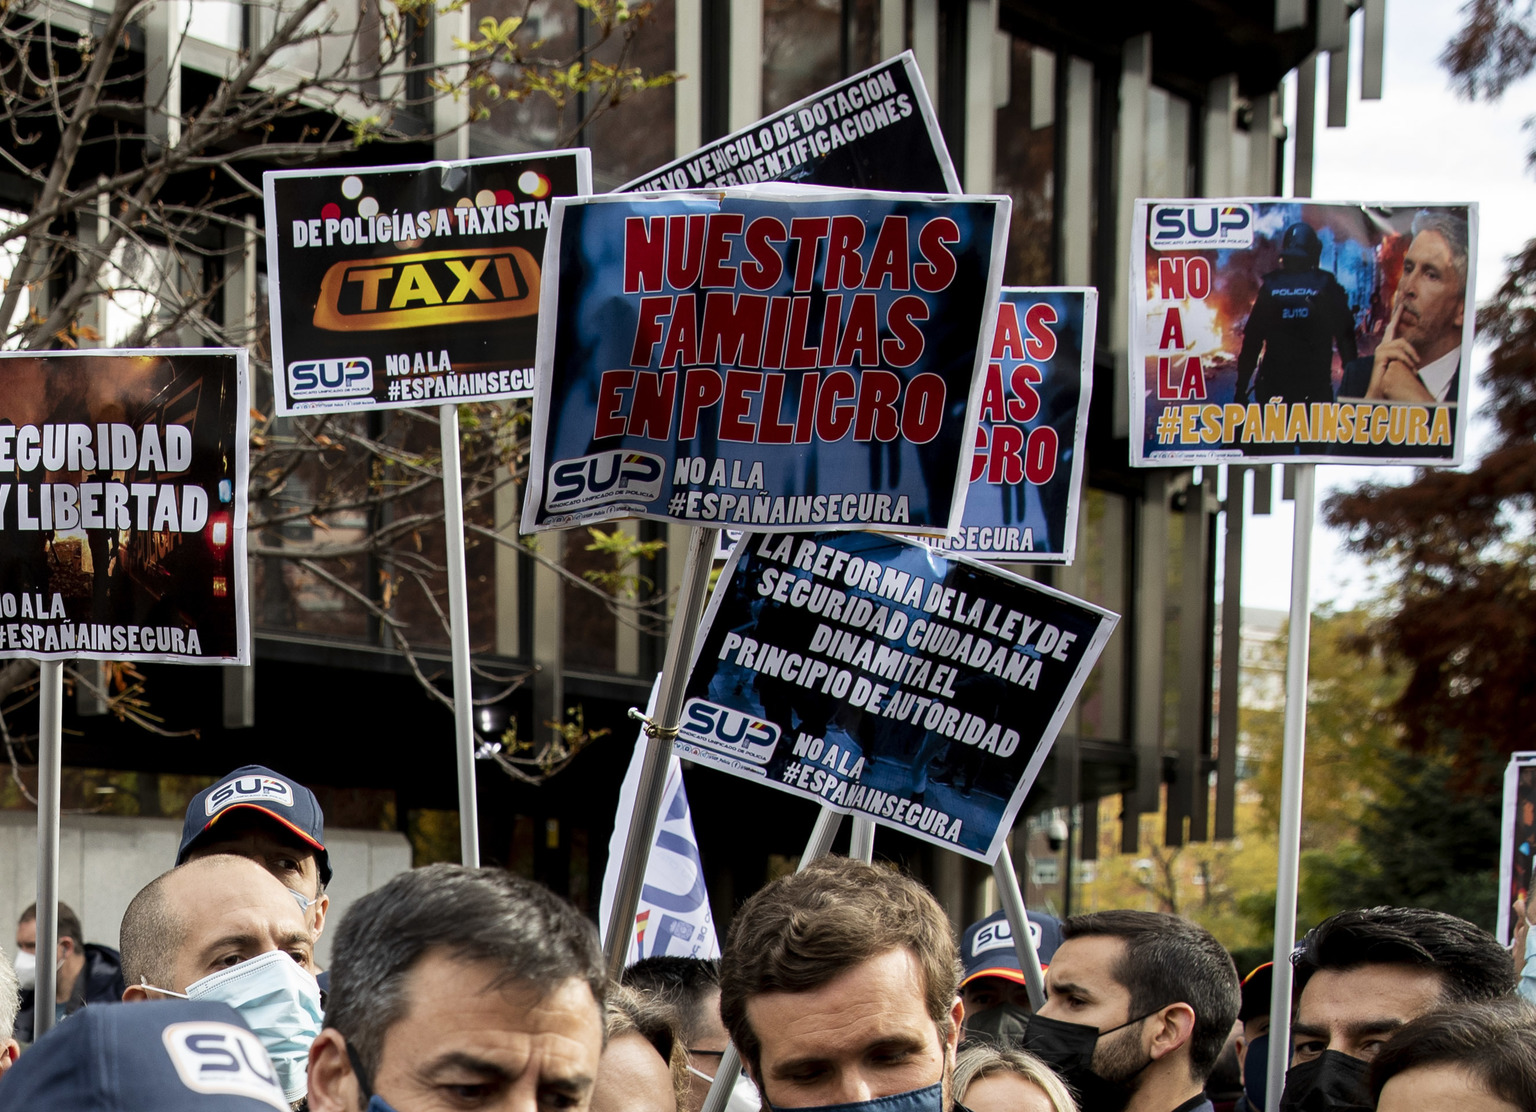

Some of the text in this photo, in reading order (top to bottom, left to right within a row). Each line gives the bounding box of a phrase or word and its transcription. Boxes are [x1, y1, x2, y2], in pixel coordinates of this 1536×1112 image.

[773, 117, 800, 147] DE
[798, 70, 897, 131] DOTACIÓN
[737, 93, 913, 186] IDENTIFICACIONES
[293, 219, 322, 248] DE
[325, 209, 431, 246] POLICÍAS
[435, 209, 451, 236] A
[1156, 207, 1249, 239] SUP
[624, 213, 959, 294] NUESTRAS
[347, 258, 519, 311] TAXI
[1158, 257, 1211, 300] NO
[630, 294, 930, 369] FAMILIAS
[1159, 307, 1185, 350] A
[293, 361, 369, 390] SUP
[386, 350, 451, 376] NO A LA
[1158, 356, 1207, 400] LA
[594, 369, 946, 445] EN PELIGRO
[1157, 396, 1452, 445] #ESPAÑAINSEGURA
[552, 454, 661, 502] SUP
[673, 457, 763, 490] NO A LA
[18, 484, 208, 532] LIBERTAD
[549, 499, 580, 509] SINDICATO
[582, 492, 613, 502] UNIFICADO
[667, 491, 910, 523] #ESPAÑAINSEGURA
[21, 593, 35, 618] A
[36, 593, 66, 618] LA
[757, 532, 1077, 661] LA REFORMA DE LA LEY DE
[757, 568, 1042, 691] SEGURIDAD CIUDADANA
[809, 624, 958, 699] DINAMITA EL
[718, 632, 1020, 758] PRINCIPIO DE AUTORIDAD
[679, 730, 707, 741] SINDICATO
[708, 739, 736, 751] UNIFICADO
[683, 703, 776, 749] SUP
[792, 733, 866, 778] NO A LA
[212, 779, 286, 807] SUP
[783, 762, 963, 843] #ESPAÑAINSEGURA
